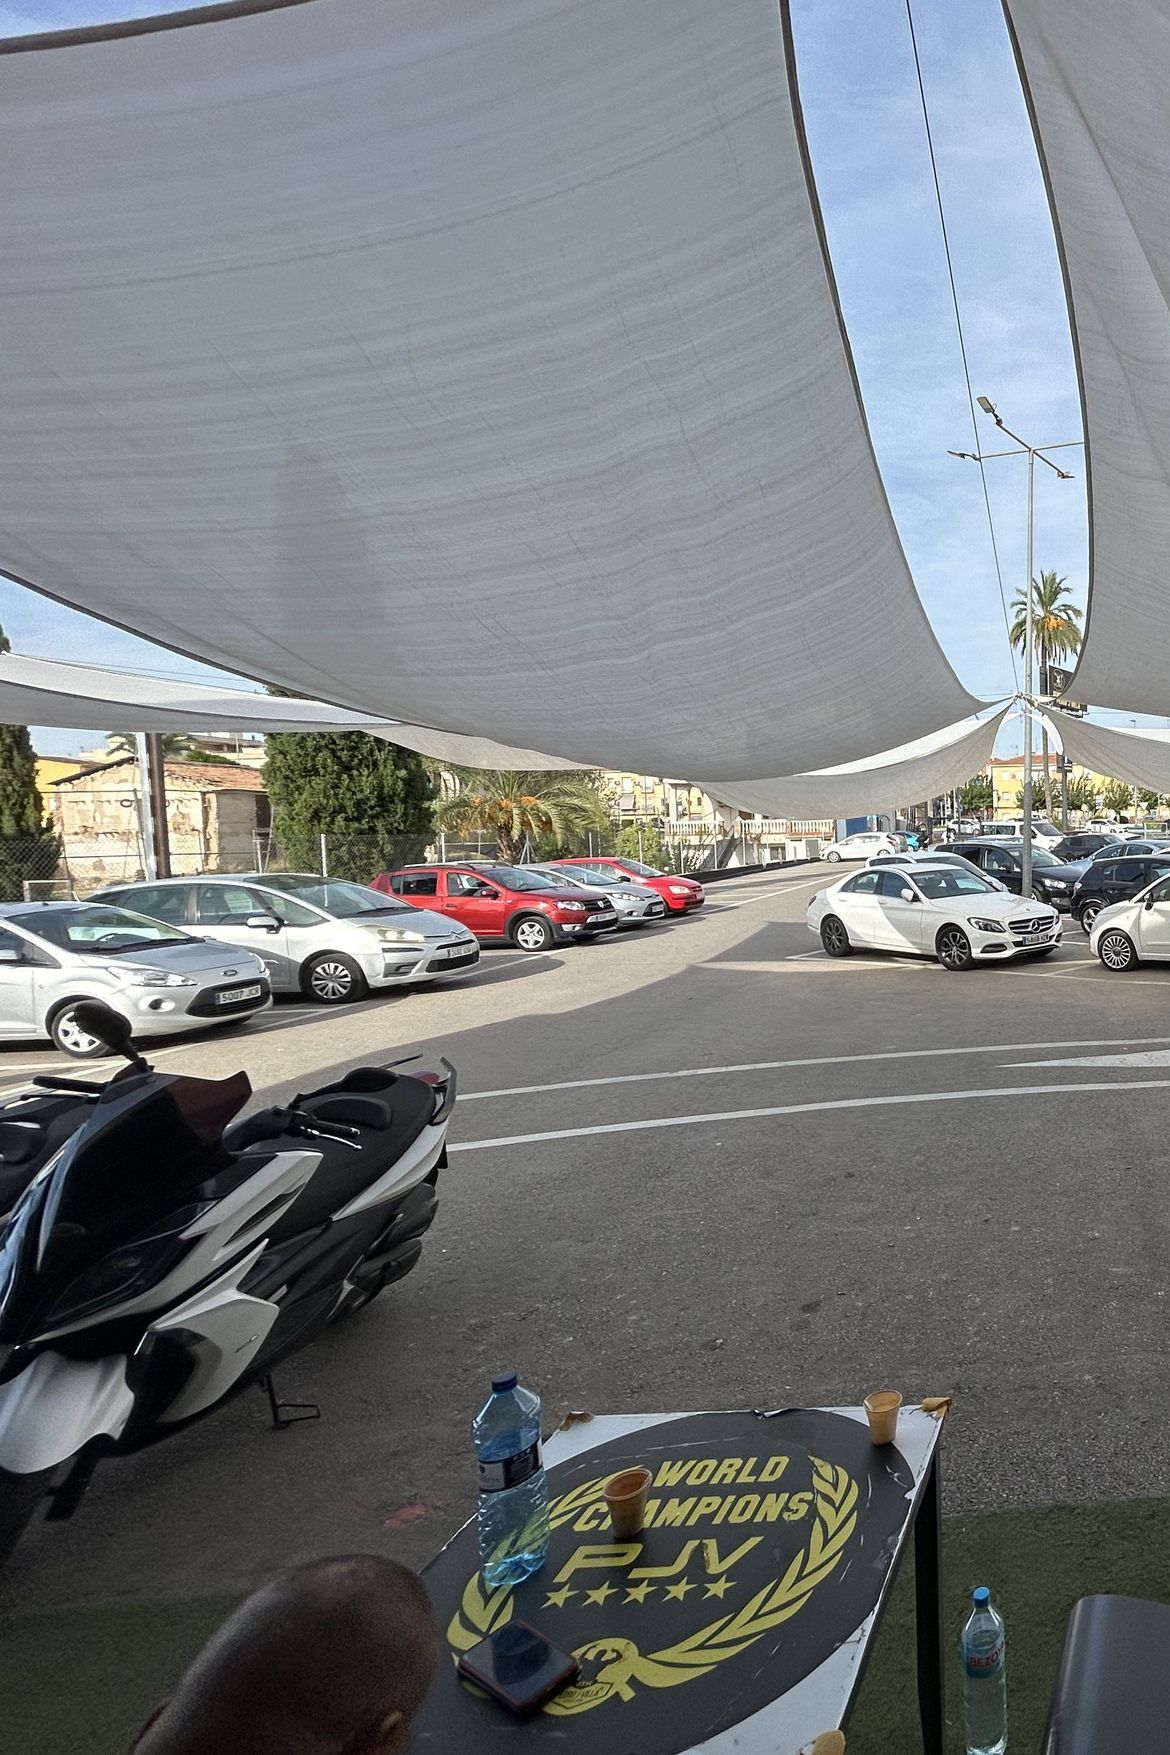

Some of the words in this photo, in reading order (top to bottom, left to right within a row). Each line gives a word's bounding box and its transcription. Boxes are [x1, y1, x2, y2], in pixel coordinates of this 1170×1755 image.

[222, 990, 244, 1002] 5007
[653, 1456, 790, 1488] WORLD
[572, 1492, 815, 1532] CAMPIONS
[552, 1536, 765, 1583] PJV
